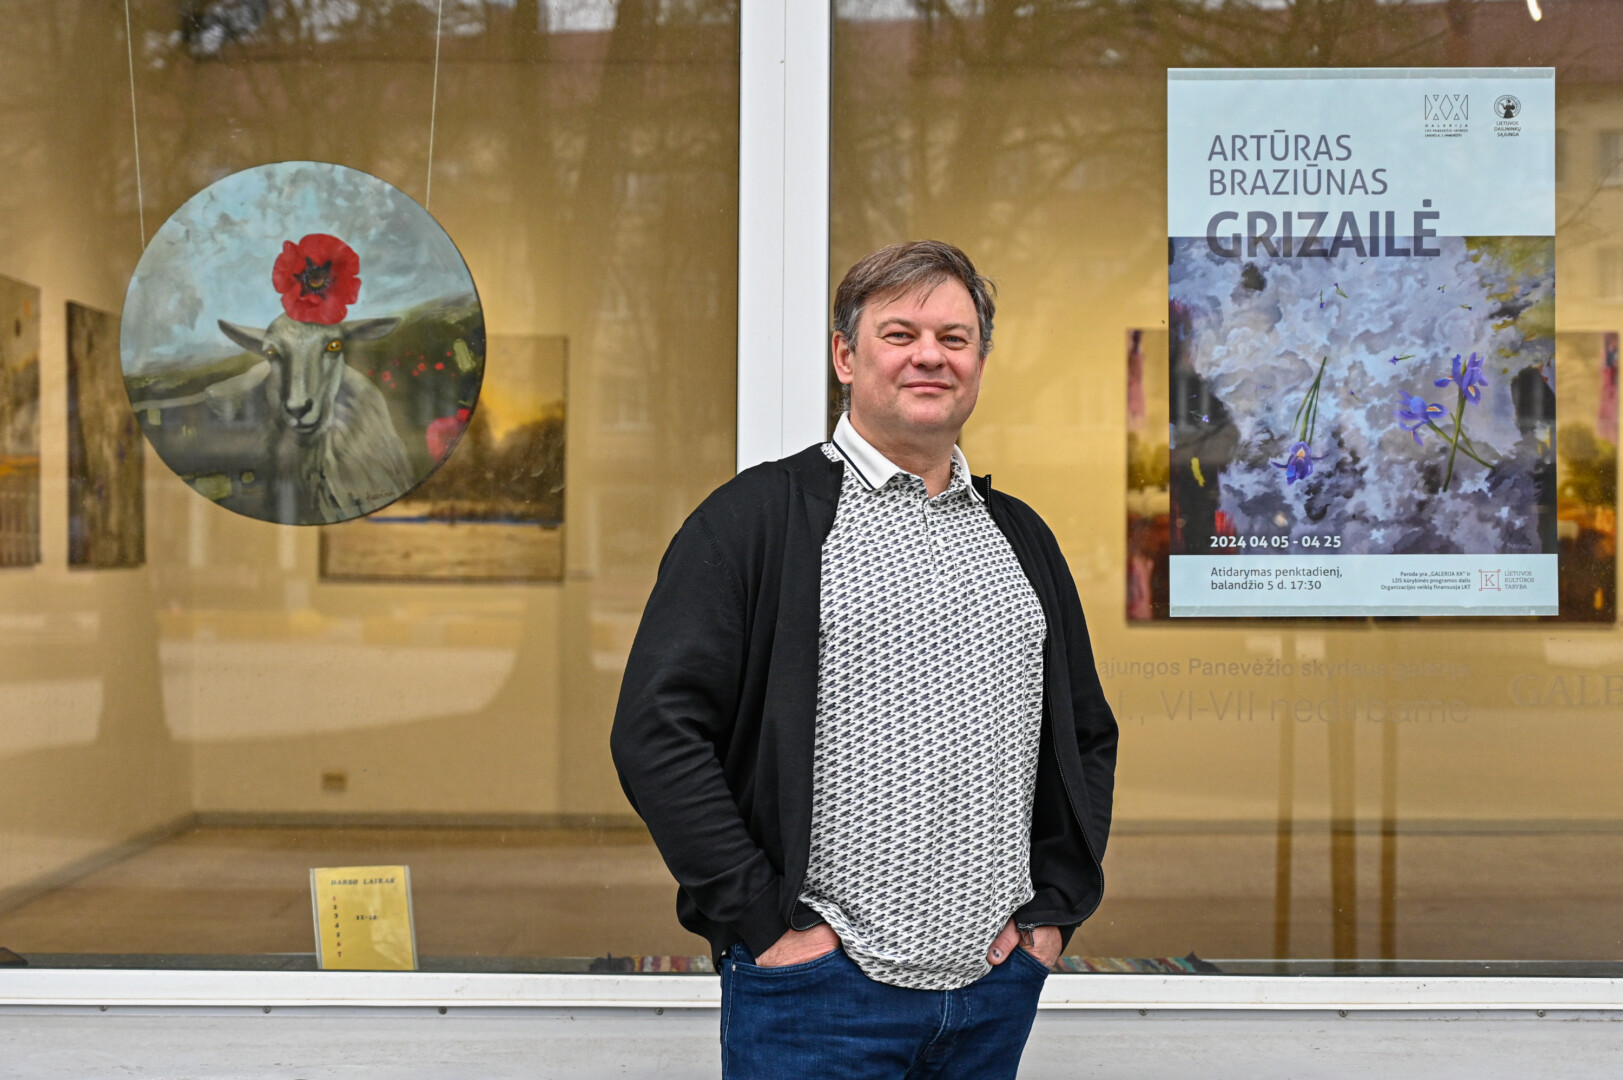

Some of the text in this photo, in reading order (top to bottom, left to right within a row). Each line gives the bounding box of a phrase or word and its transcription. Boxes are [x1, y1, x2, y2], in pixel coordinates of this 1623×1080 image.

[1208, 129, 1353, 162] ARTŪRAS
[1209, 163, 1389, 196] BRAZIŪNAS
[1206, 198, 1441, 258] GRIZAILĖ
[1210, 535, 1247, 549] 2024
[1249, 535, 1268, 549] 04
[1271, 535, 1289, 548] 05
[1301, 535, 1321, 549] 04
[1323, 535, 1342, 548] 25
[1210, 566, 1343, 579] Atidarymas penktadienį,
[1211, 580, 1322, 590] balandžio 5 d. 17:30
[1187, 657, 1294, 677] Panevėžio
[1161, 689, 1253, 722] VI-VII
